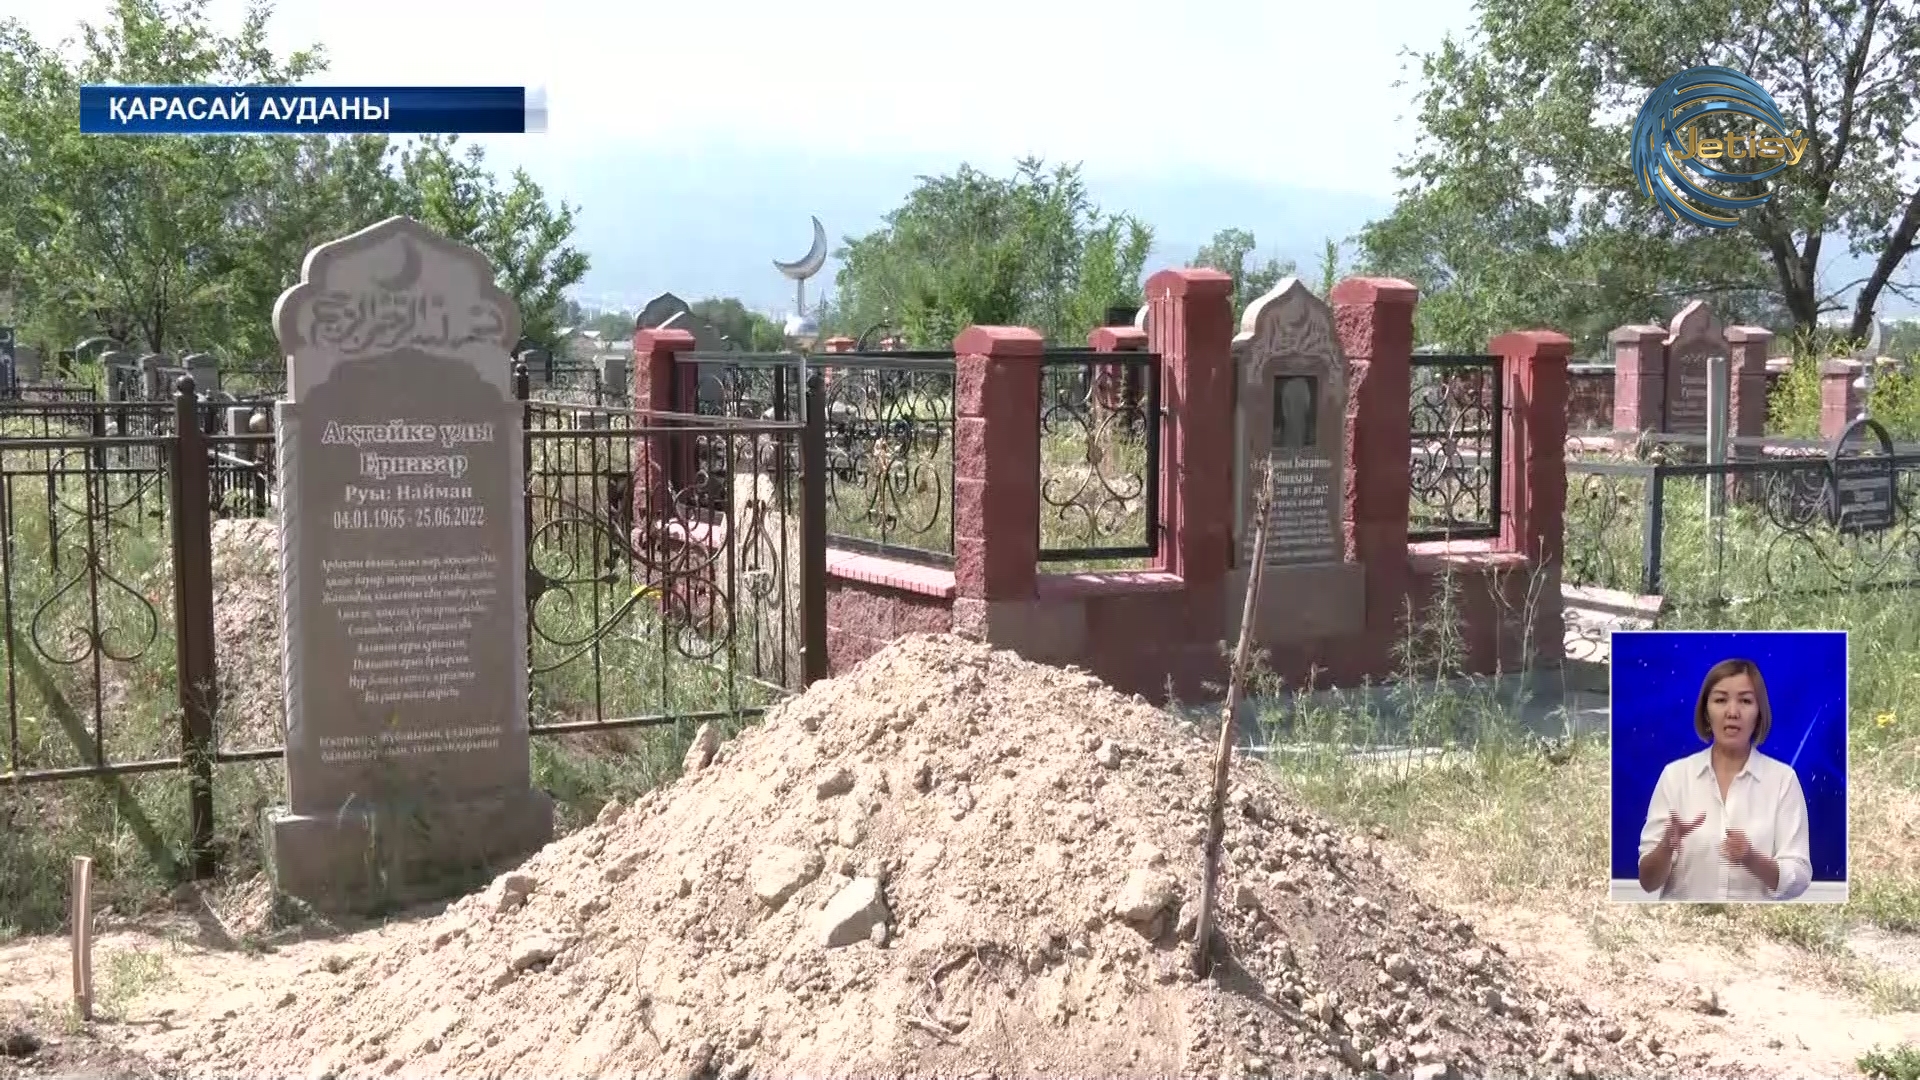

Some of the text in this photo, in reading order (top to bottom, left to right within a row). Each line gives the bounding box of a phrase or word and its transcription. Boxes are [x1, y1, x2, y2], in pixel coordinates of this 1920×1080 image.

[359, 451, 469, 480] Ерназар
[345, 483, 473, 505] Руы: Найман
[333, 509, 406, 530] 04.01.1965
[415, 506, 486, 527] 25.06.2022
